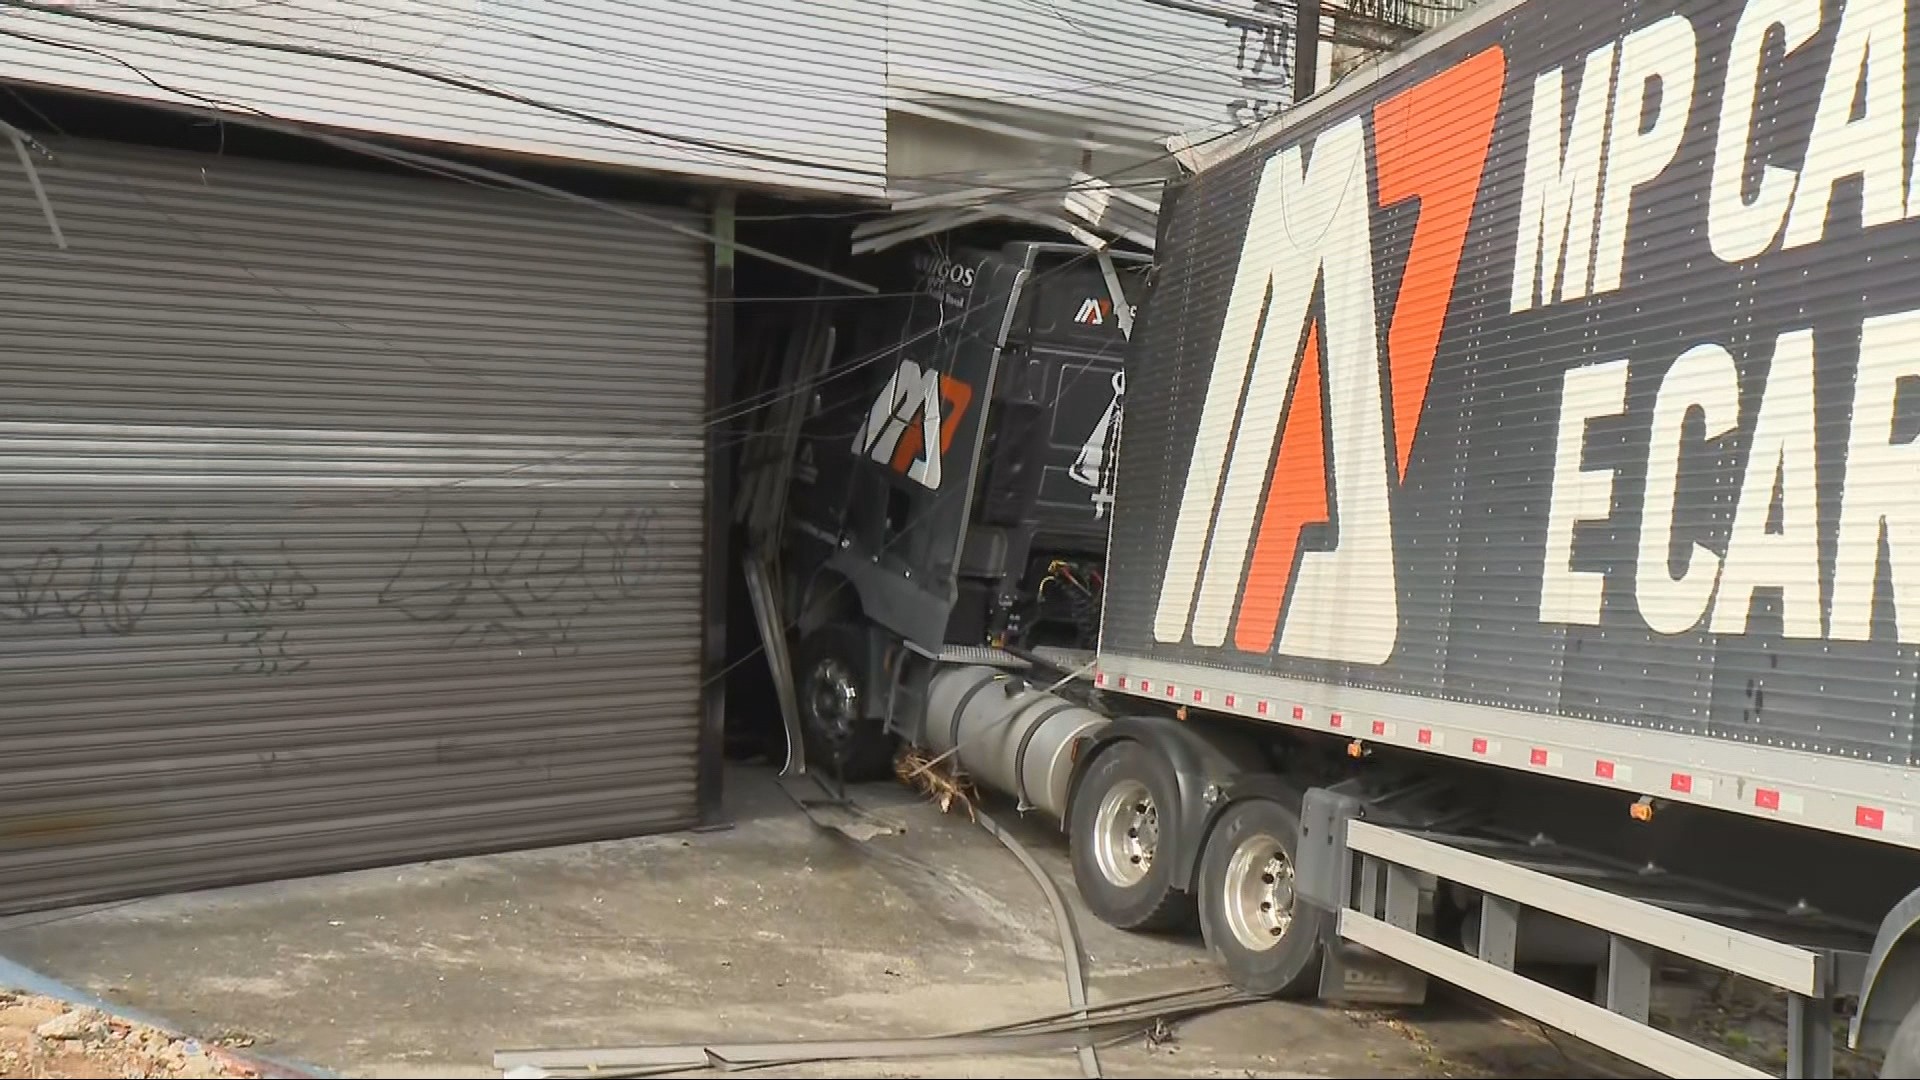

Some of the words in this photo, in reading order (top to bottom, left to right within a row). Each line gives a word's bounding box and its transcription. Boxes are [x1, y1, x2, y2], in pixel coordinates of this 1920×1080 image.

[1510, 14, 1697, 314] MP
[1707, 0, 1920, 262] CA
[1538, 359, 1630, 624] E
